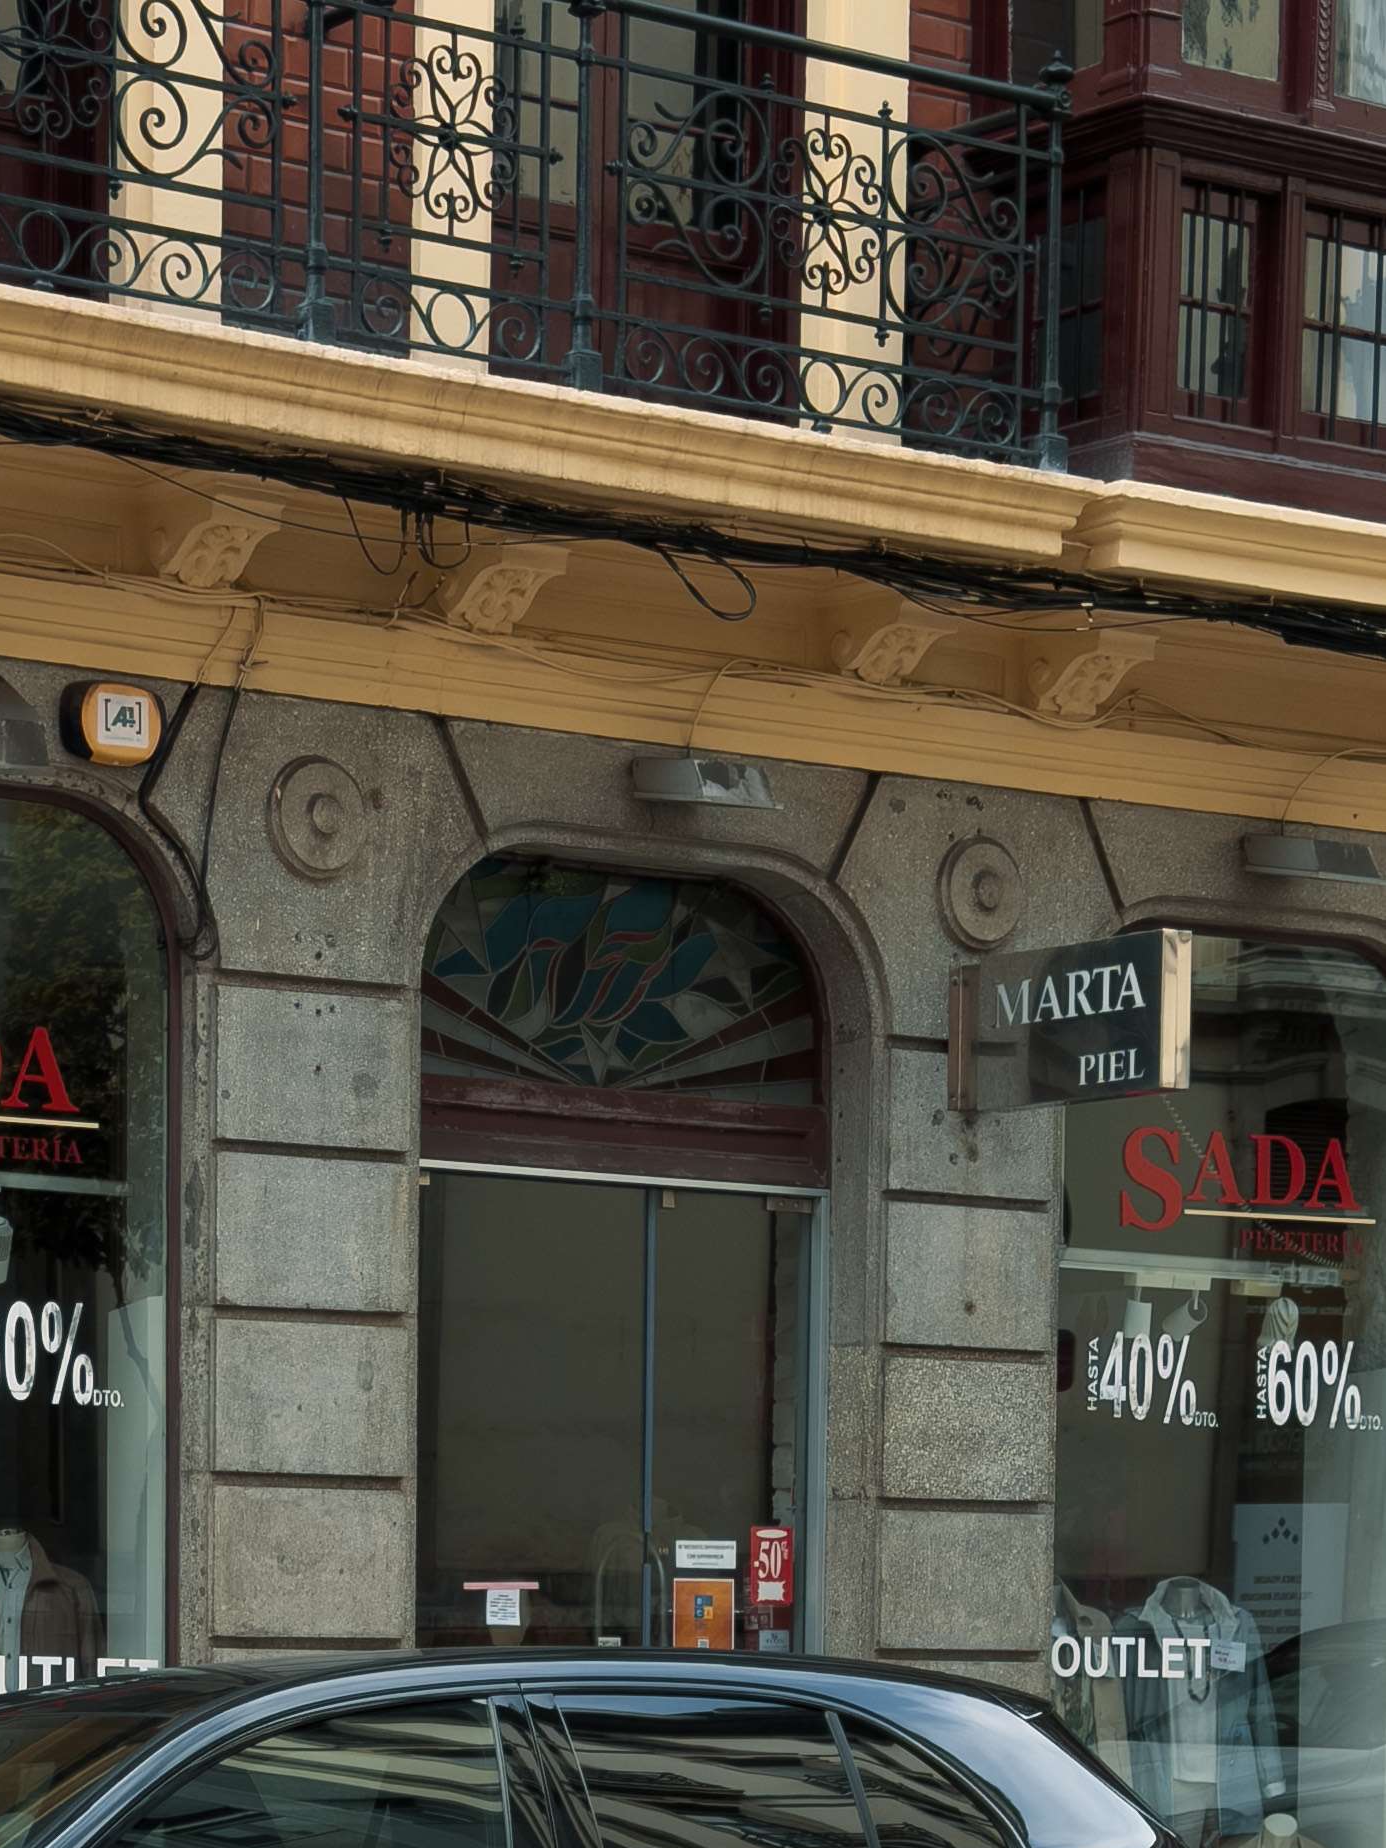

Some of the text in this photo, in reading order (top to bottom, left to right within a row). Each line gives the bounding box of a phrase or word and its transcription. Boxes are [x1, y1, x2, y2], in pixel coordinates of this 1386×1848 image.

[995, 961, 1146, 1029] MARTA
[1078, 1048, 1145, 1086] PIEL
[1119, 1126, 1362, 1232] SADA
[93, 1389, 125, 1407] DTO.
[1087, 1331, 1218, 1428] HASTA 40% DTO.
[1256, 1340, 1384, 1431] HASTA 60% DTO.
[1051, 1636, 1211, 1680] OUTLET
